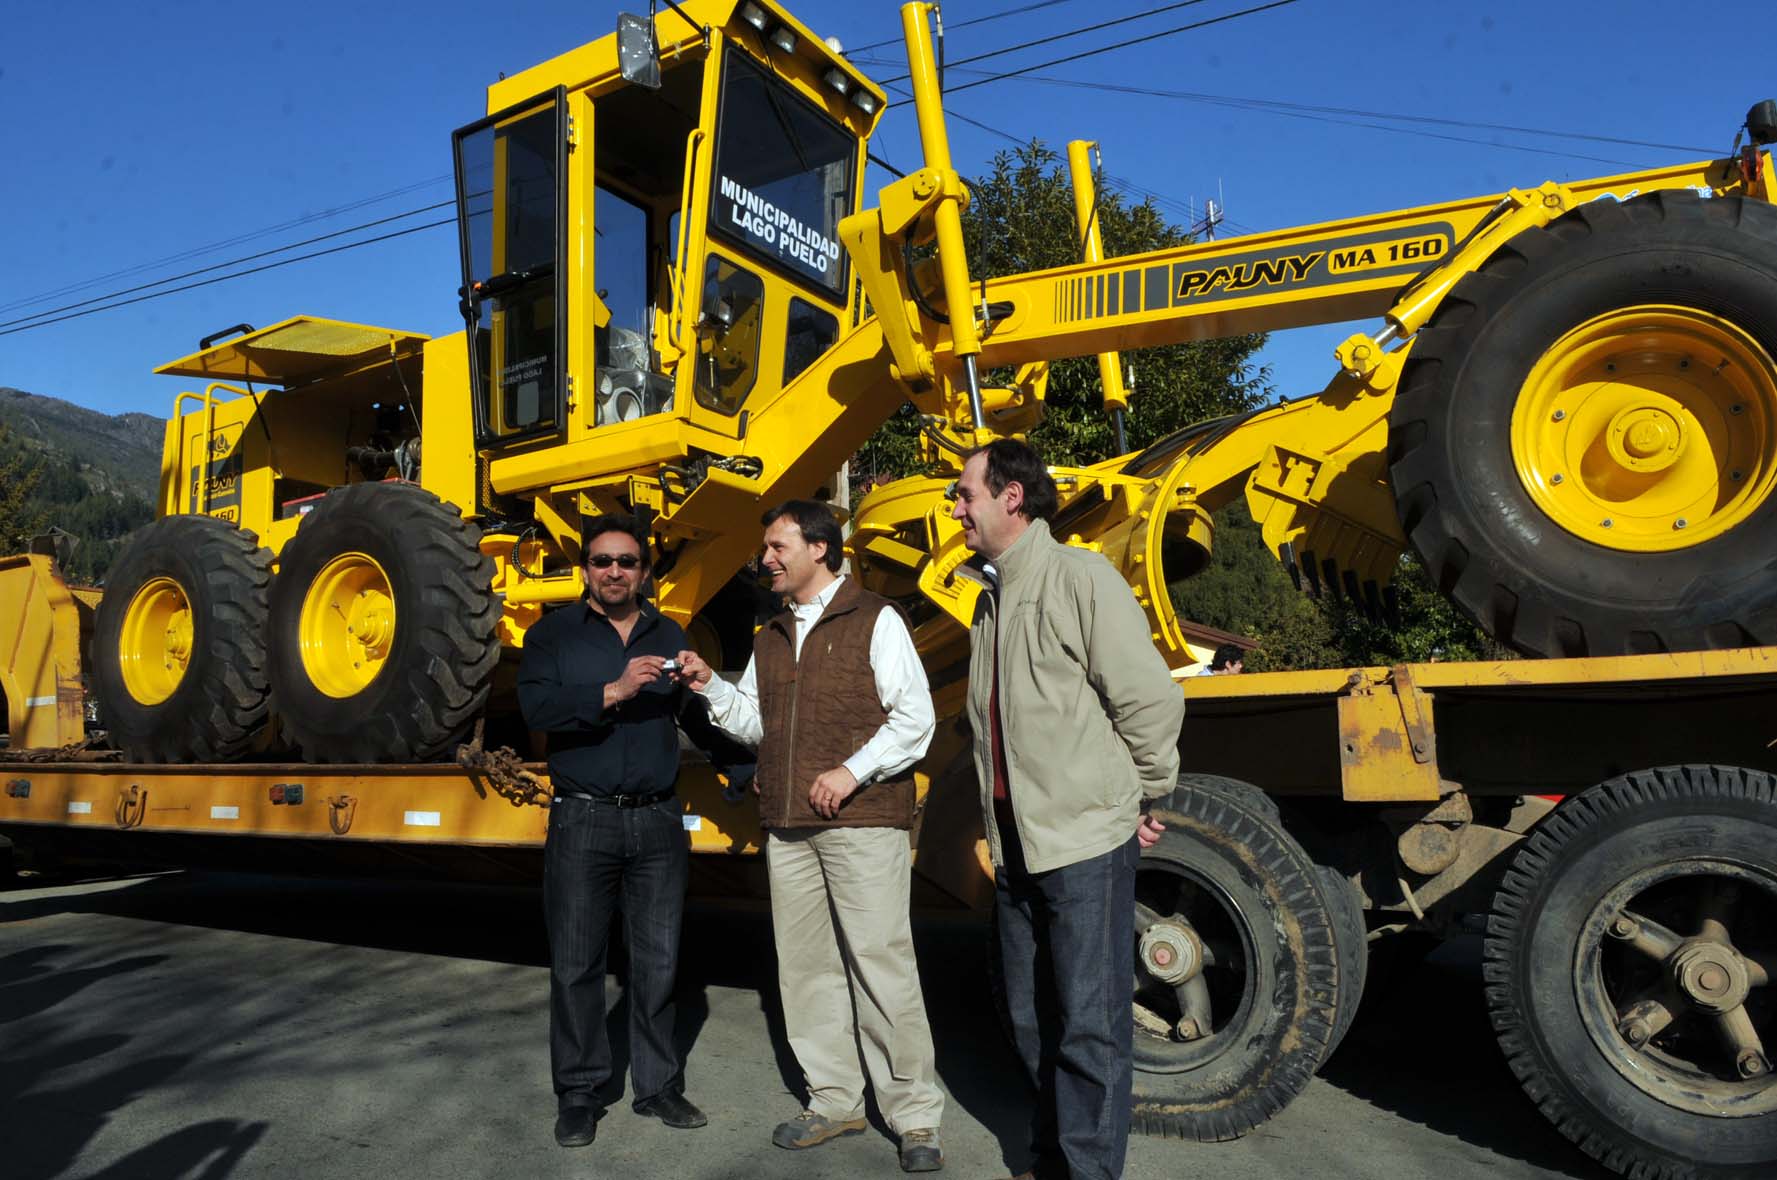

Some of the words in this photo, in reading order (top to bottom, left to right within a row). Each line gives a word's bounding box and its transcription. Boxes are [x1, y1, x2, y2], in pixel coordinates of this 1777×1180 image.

[721, 176, 839, 260] MUNICIPALIDAD
[732, 204, 776, 243] LAGO
[779, 232, 828, 273] PUELO
[1177, 251, 1326, 298] PAUNY
[1333, 249, 1376, 270] MA
[1388, 239, 1442, 261] 160
[192, 472, 239, 496] PUNY
